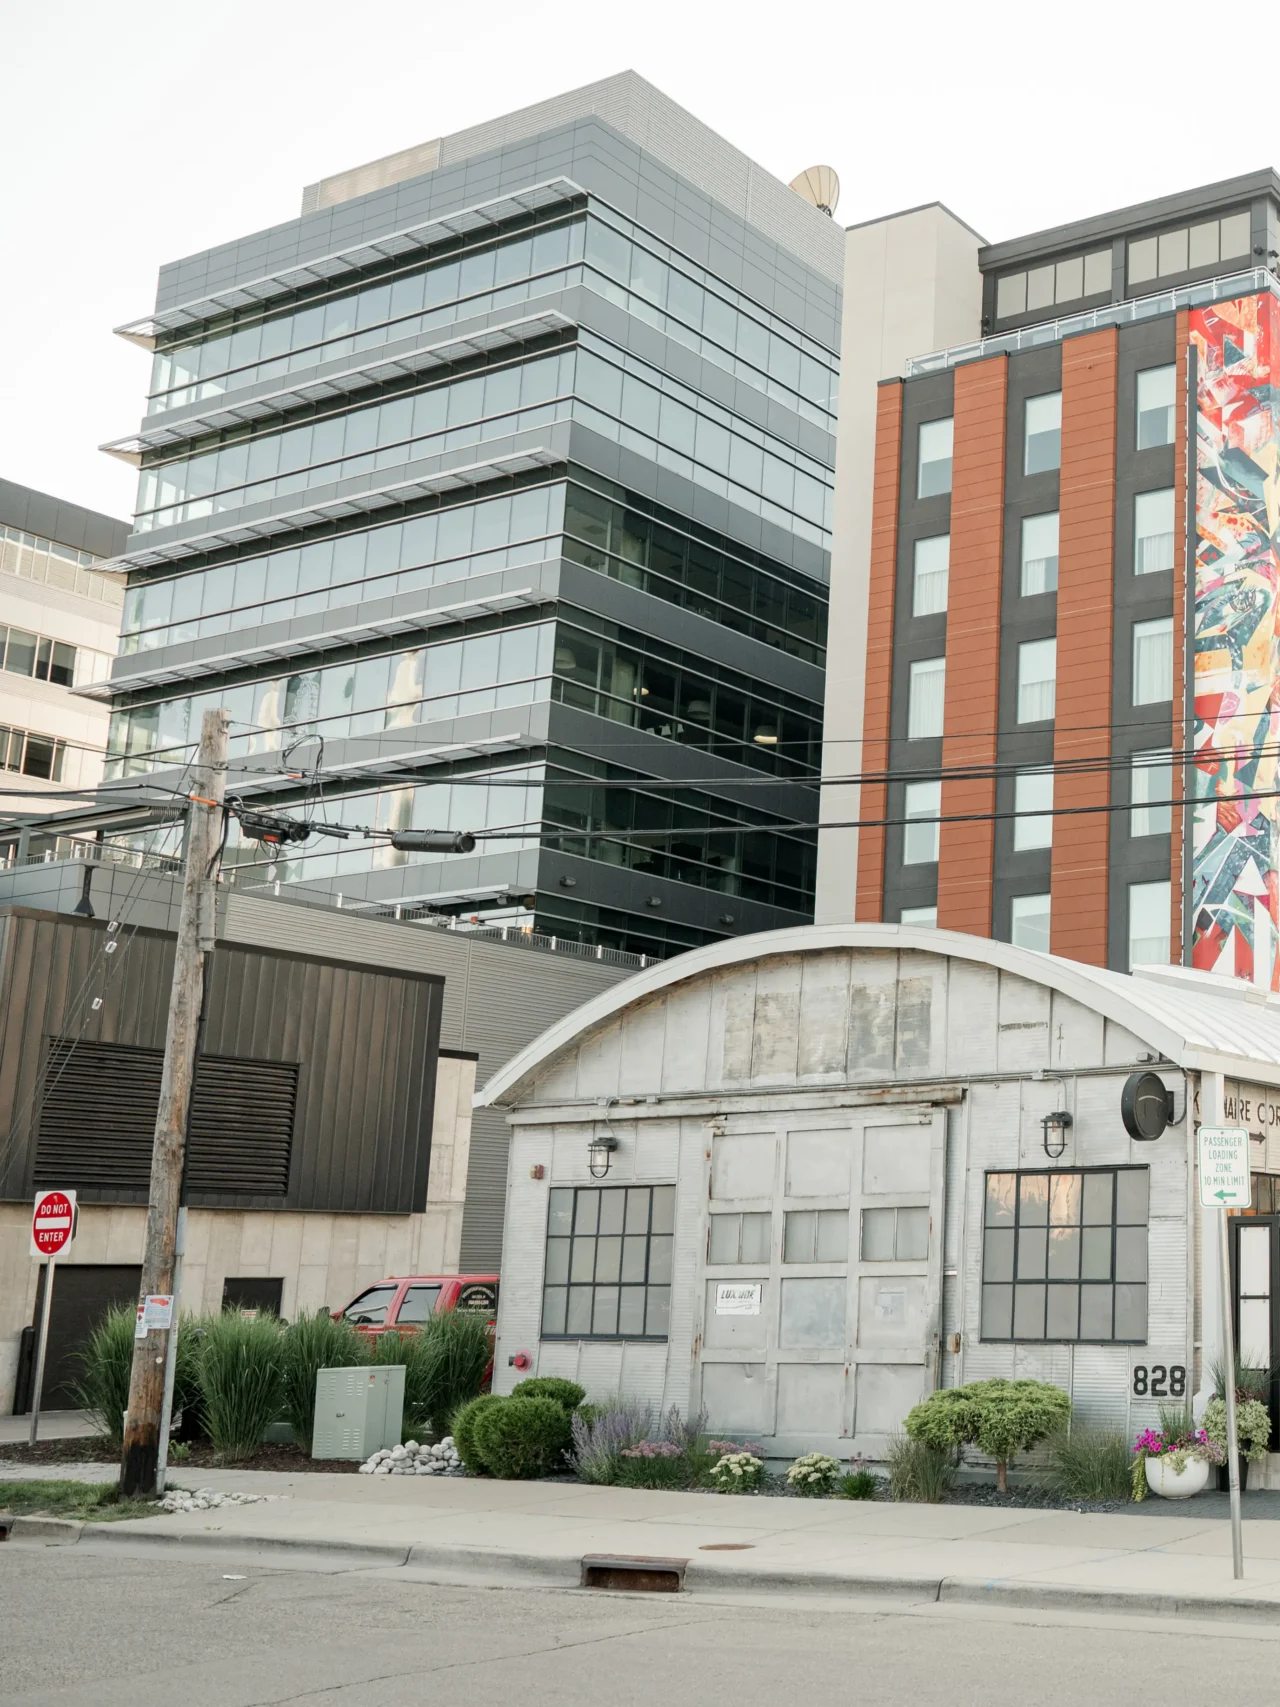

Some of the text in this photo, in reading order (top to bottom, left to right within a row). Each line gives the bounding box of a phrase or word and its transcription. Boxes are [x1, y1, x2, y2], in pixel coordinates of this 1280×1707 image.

[1203, 1136, 1243, 1147] PASSENGER
[1208, 1149, 1238, 1160] LOADING
[1215, 1162, 1232, 1173] ZONE
[1204, 1176, 1244, 1186] 10 MIN LIMIT
[41, 1203, 68, 1215] DO NOT
[38, 1231, 64, 1243] ENTER
[1133, 1364, 1186, 1397] 828
